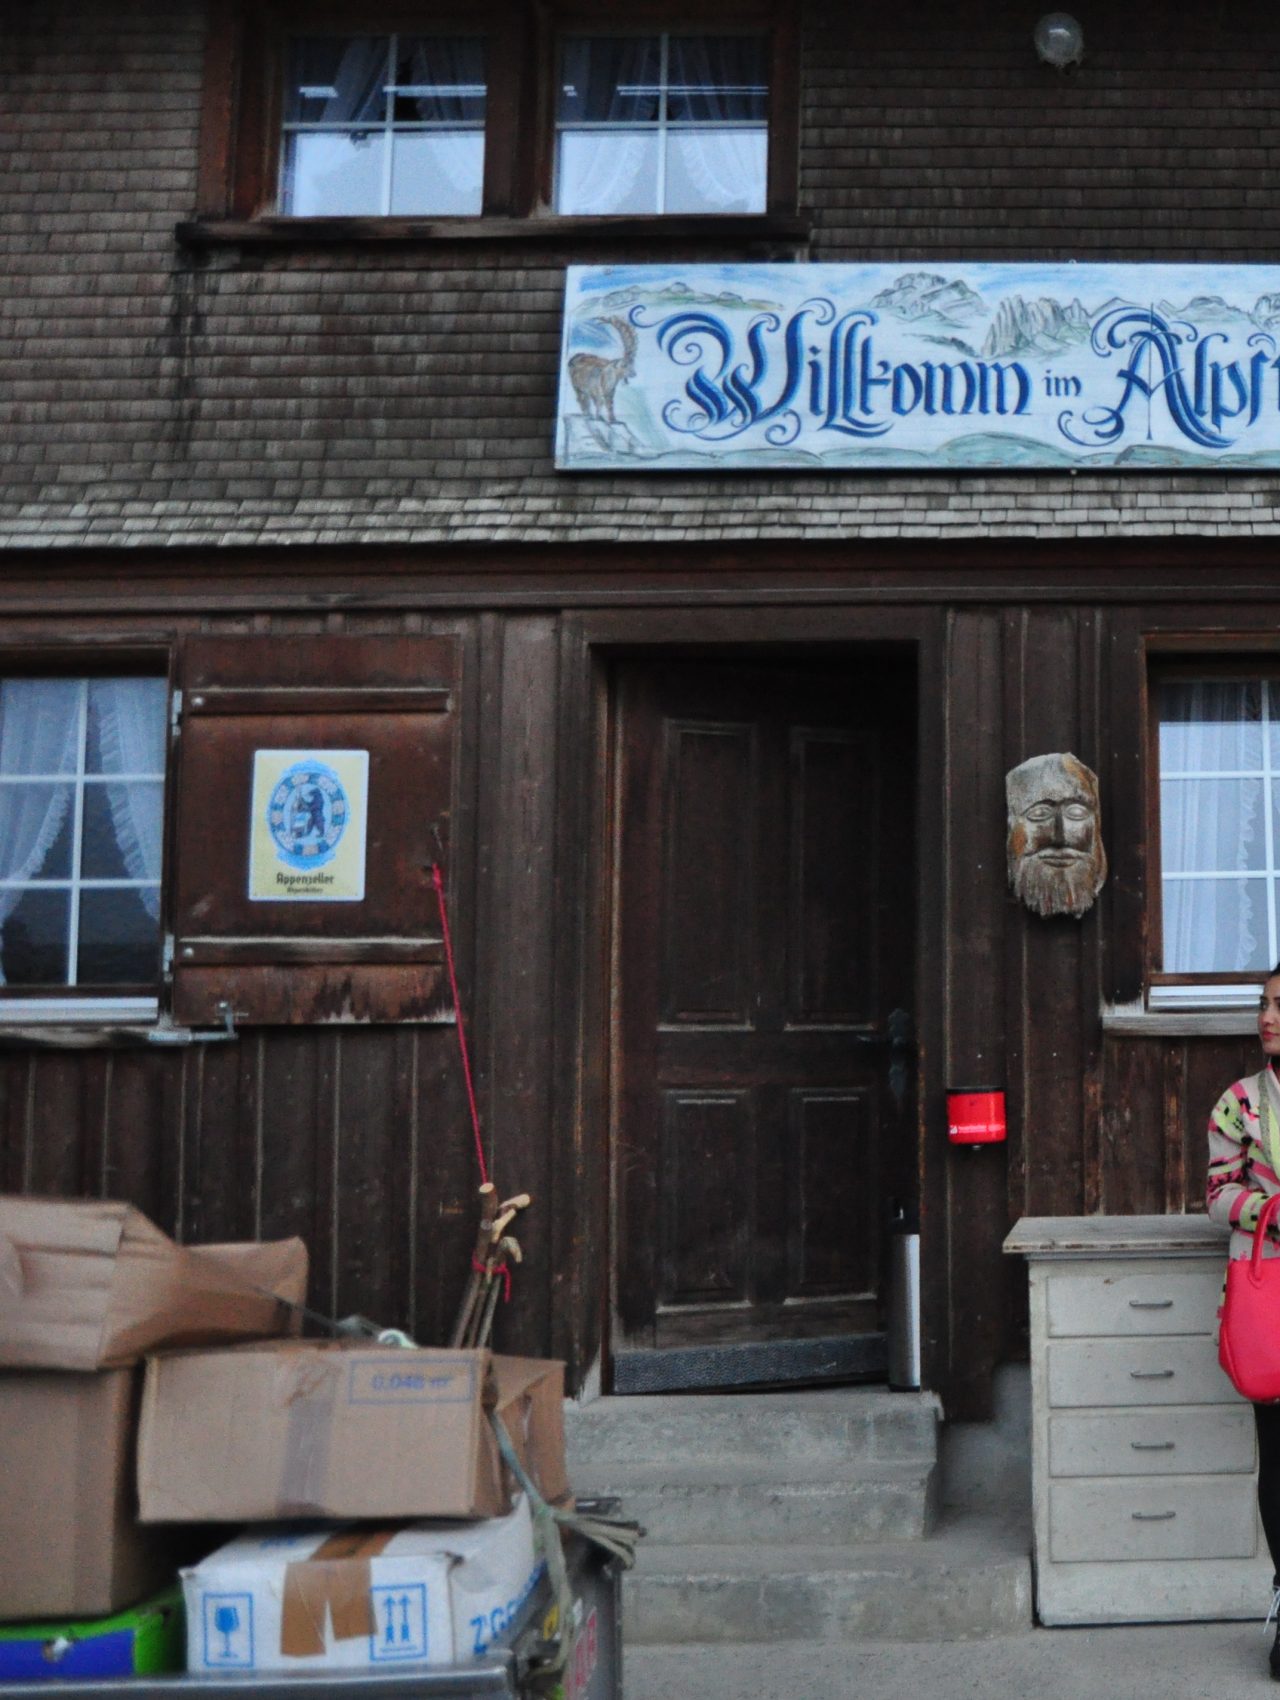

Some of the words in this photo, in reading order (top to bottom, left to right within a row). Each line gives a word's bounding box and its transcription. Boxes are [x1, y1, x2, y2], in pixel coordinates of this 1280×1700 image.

[629, 298, 1033, 446] Willkomm
[1044, 369, 1082, 397] im
[276, 871, 335, 885] Appenzeller
